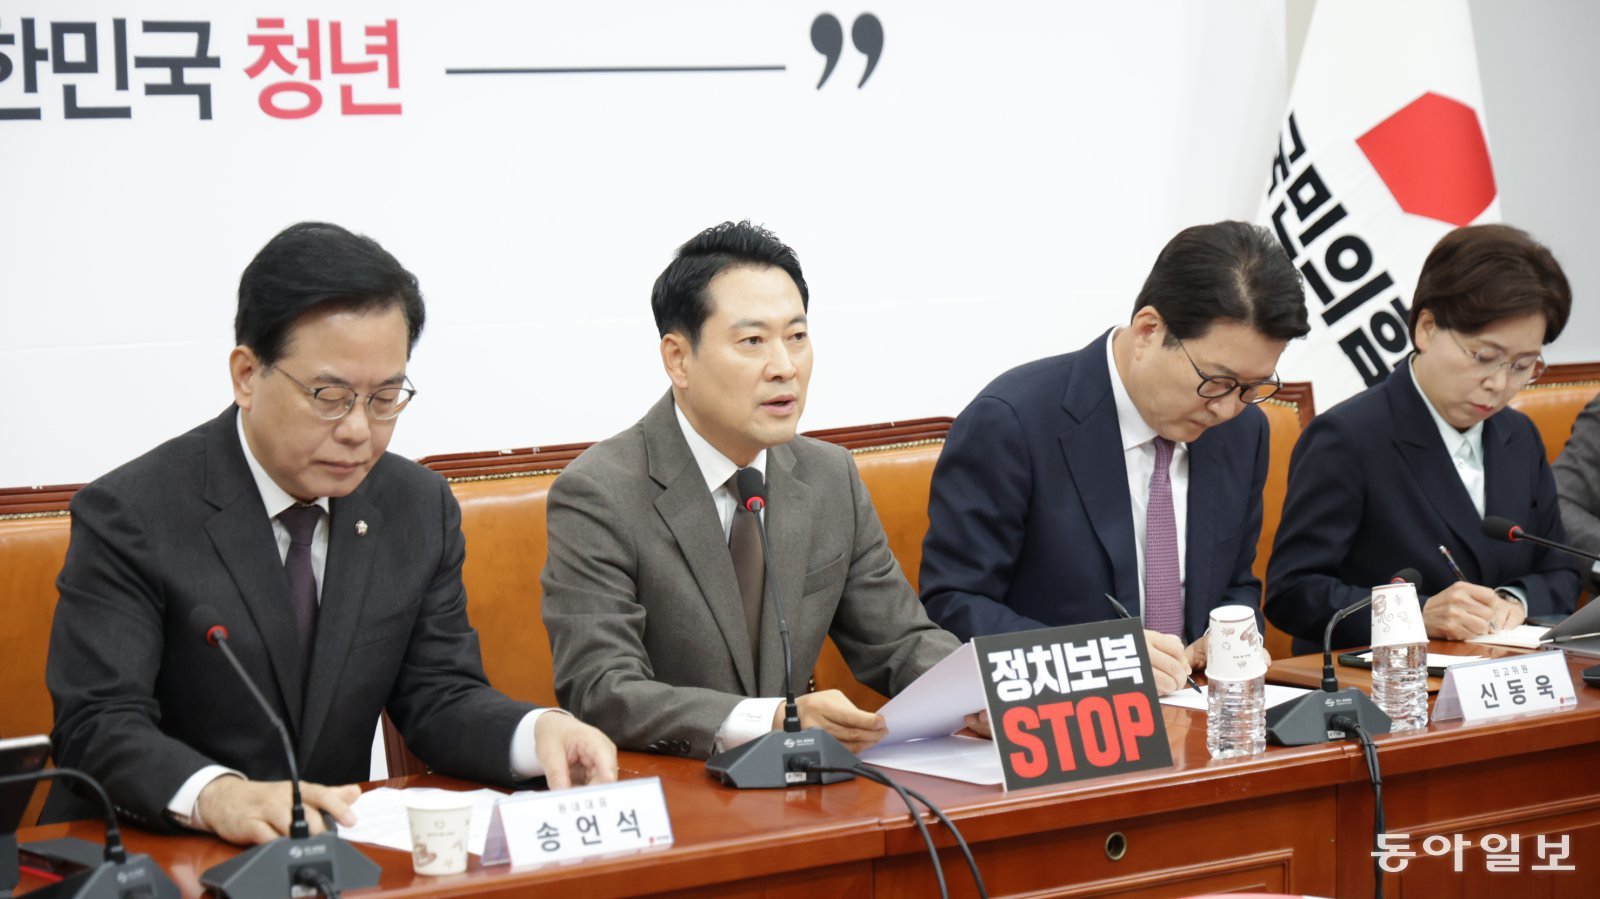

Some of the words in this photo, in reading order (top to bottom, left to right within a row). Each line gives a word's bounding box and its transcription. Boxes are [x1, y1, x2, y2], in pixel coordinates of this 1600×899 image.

[0, 16, 221, 121] 한민국
[243, 17, 403, 119] 청년
[987, 633, 1144, 702] 정치보복
[1480, 674, 1555, 709] 신동욱
[1002, 691, 1155, 779] STOP
[536, 809, 642, 852] 송언석
